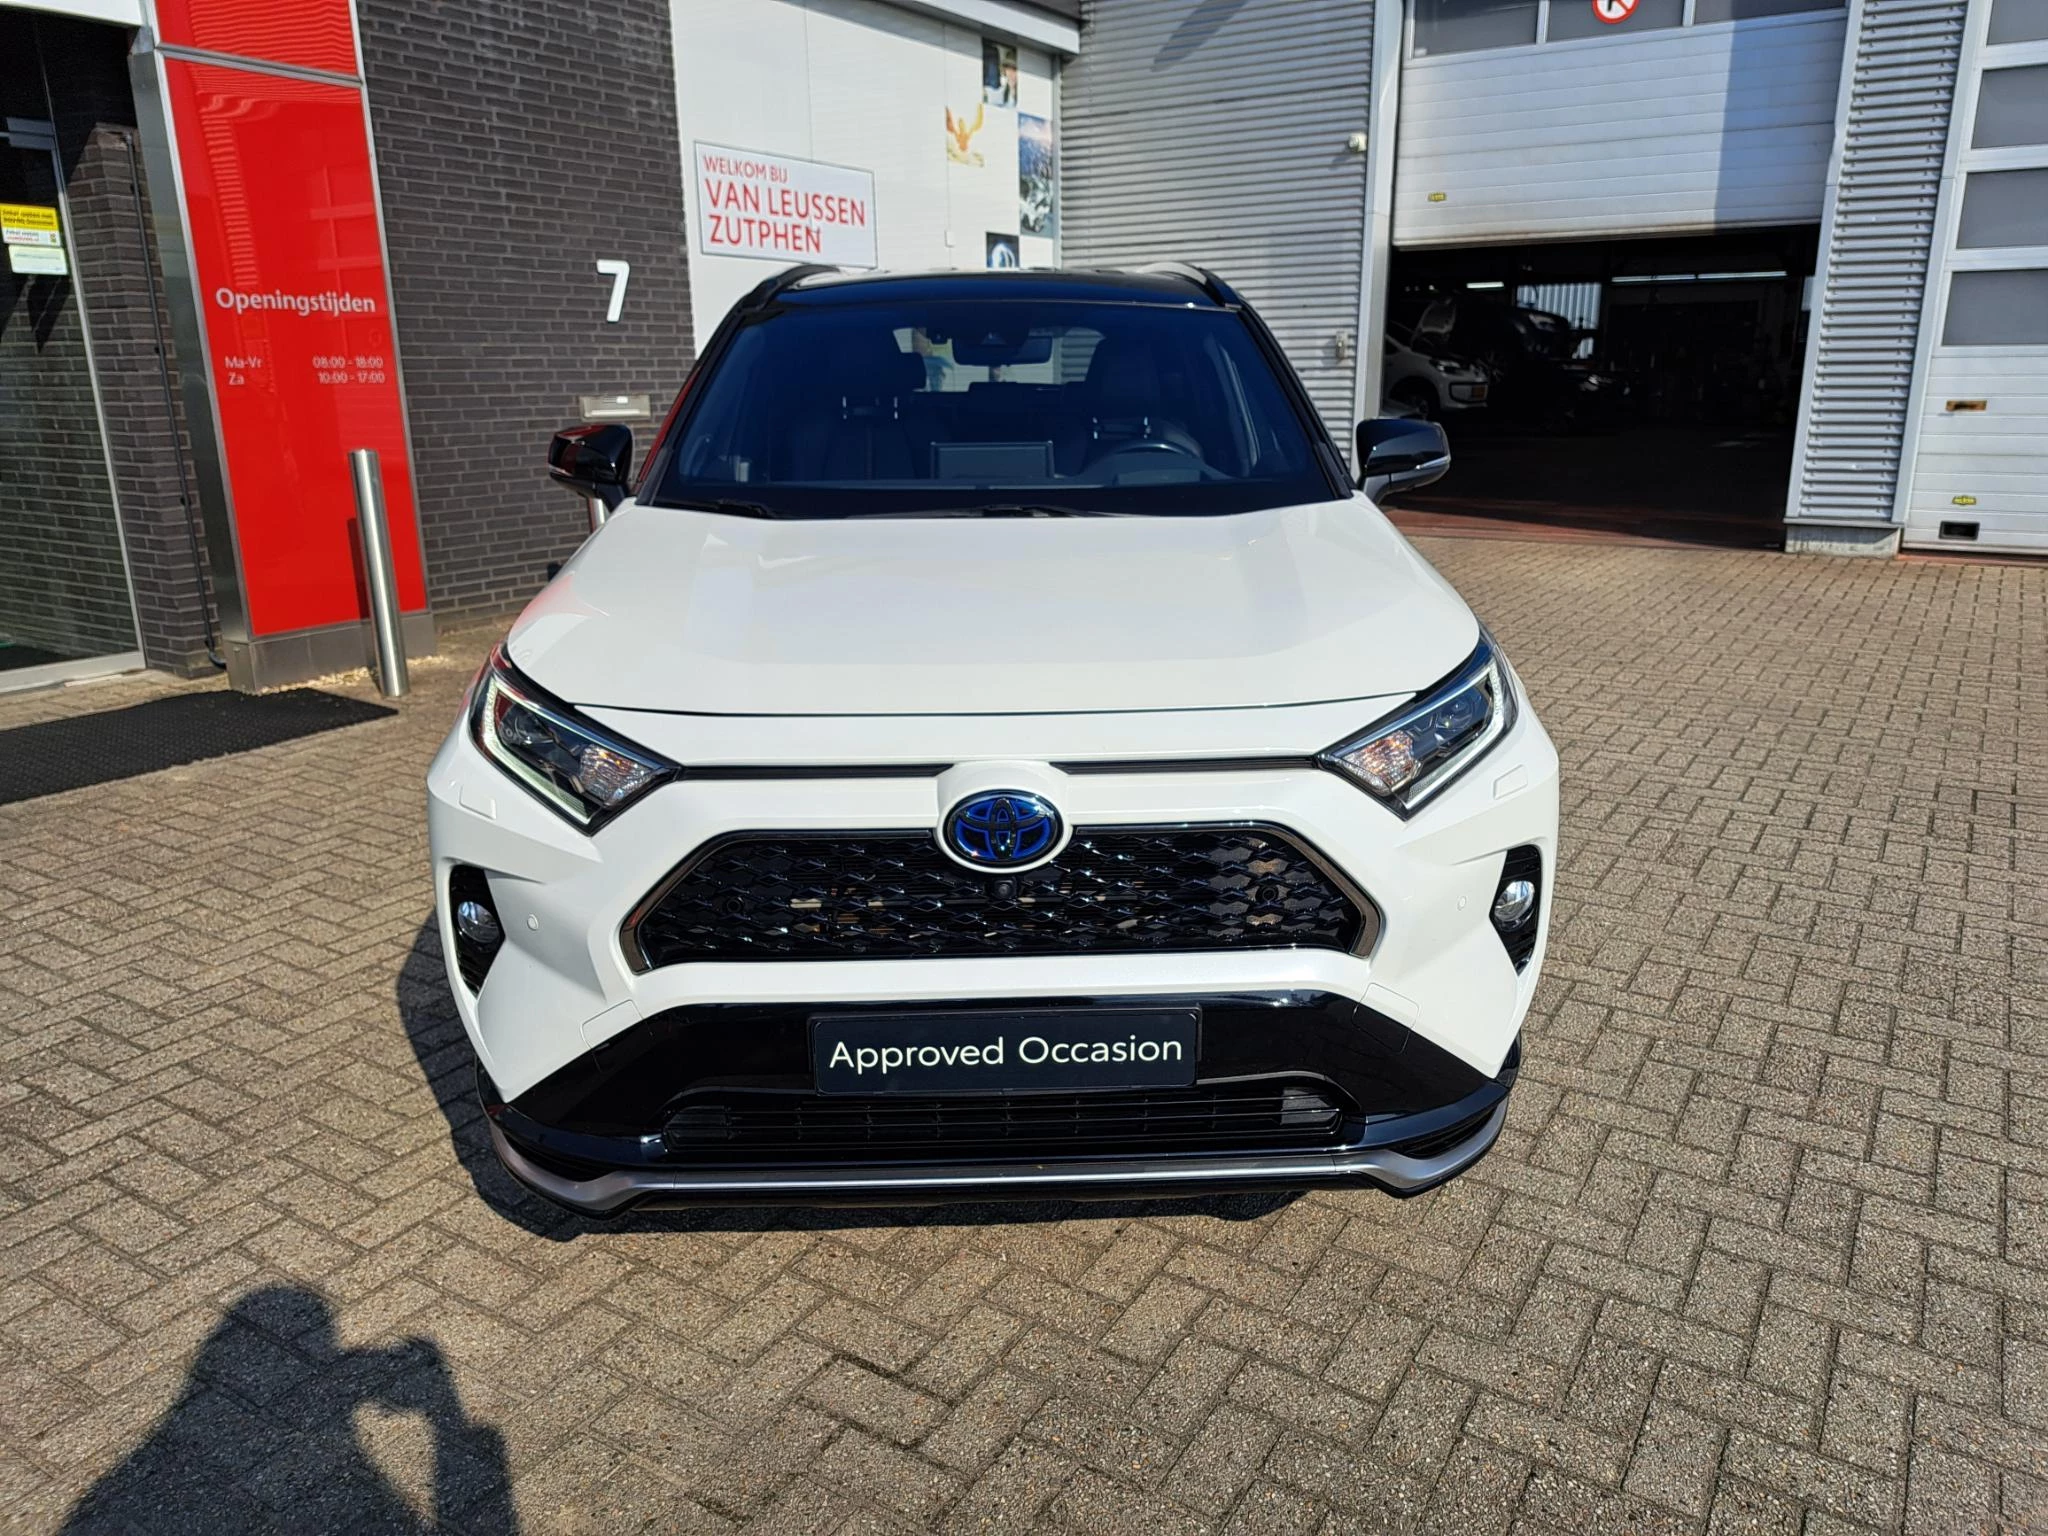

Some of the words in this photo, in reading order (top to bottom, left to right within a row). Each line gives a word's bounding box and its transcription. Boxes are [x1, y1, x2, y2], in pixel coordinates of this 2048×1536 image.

[703, 155, 767, 180] WELKOM
[770, 168, 788, 184] BIJ
[705, 178, 760, 213] VAN
[767, 187, 865, 226] LEUSSEN
[709, 215, 821, 253] ZUTPHEN
[216, 287, 375, 317] Openingstijden
[596, 259, 630, 322] 7
[225, 355, 262, 369] Ma-Vr
[312, 356, 346, 369] 08:00
[356, 356, 384, 369] 18:00
[228, 372, 245, 385] Za
[829, 1036, 1004, 1074] Approved
[1018, 1034, 1183, 1063] Occasion
